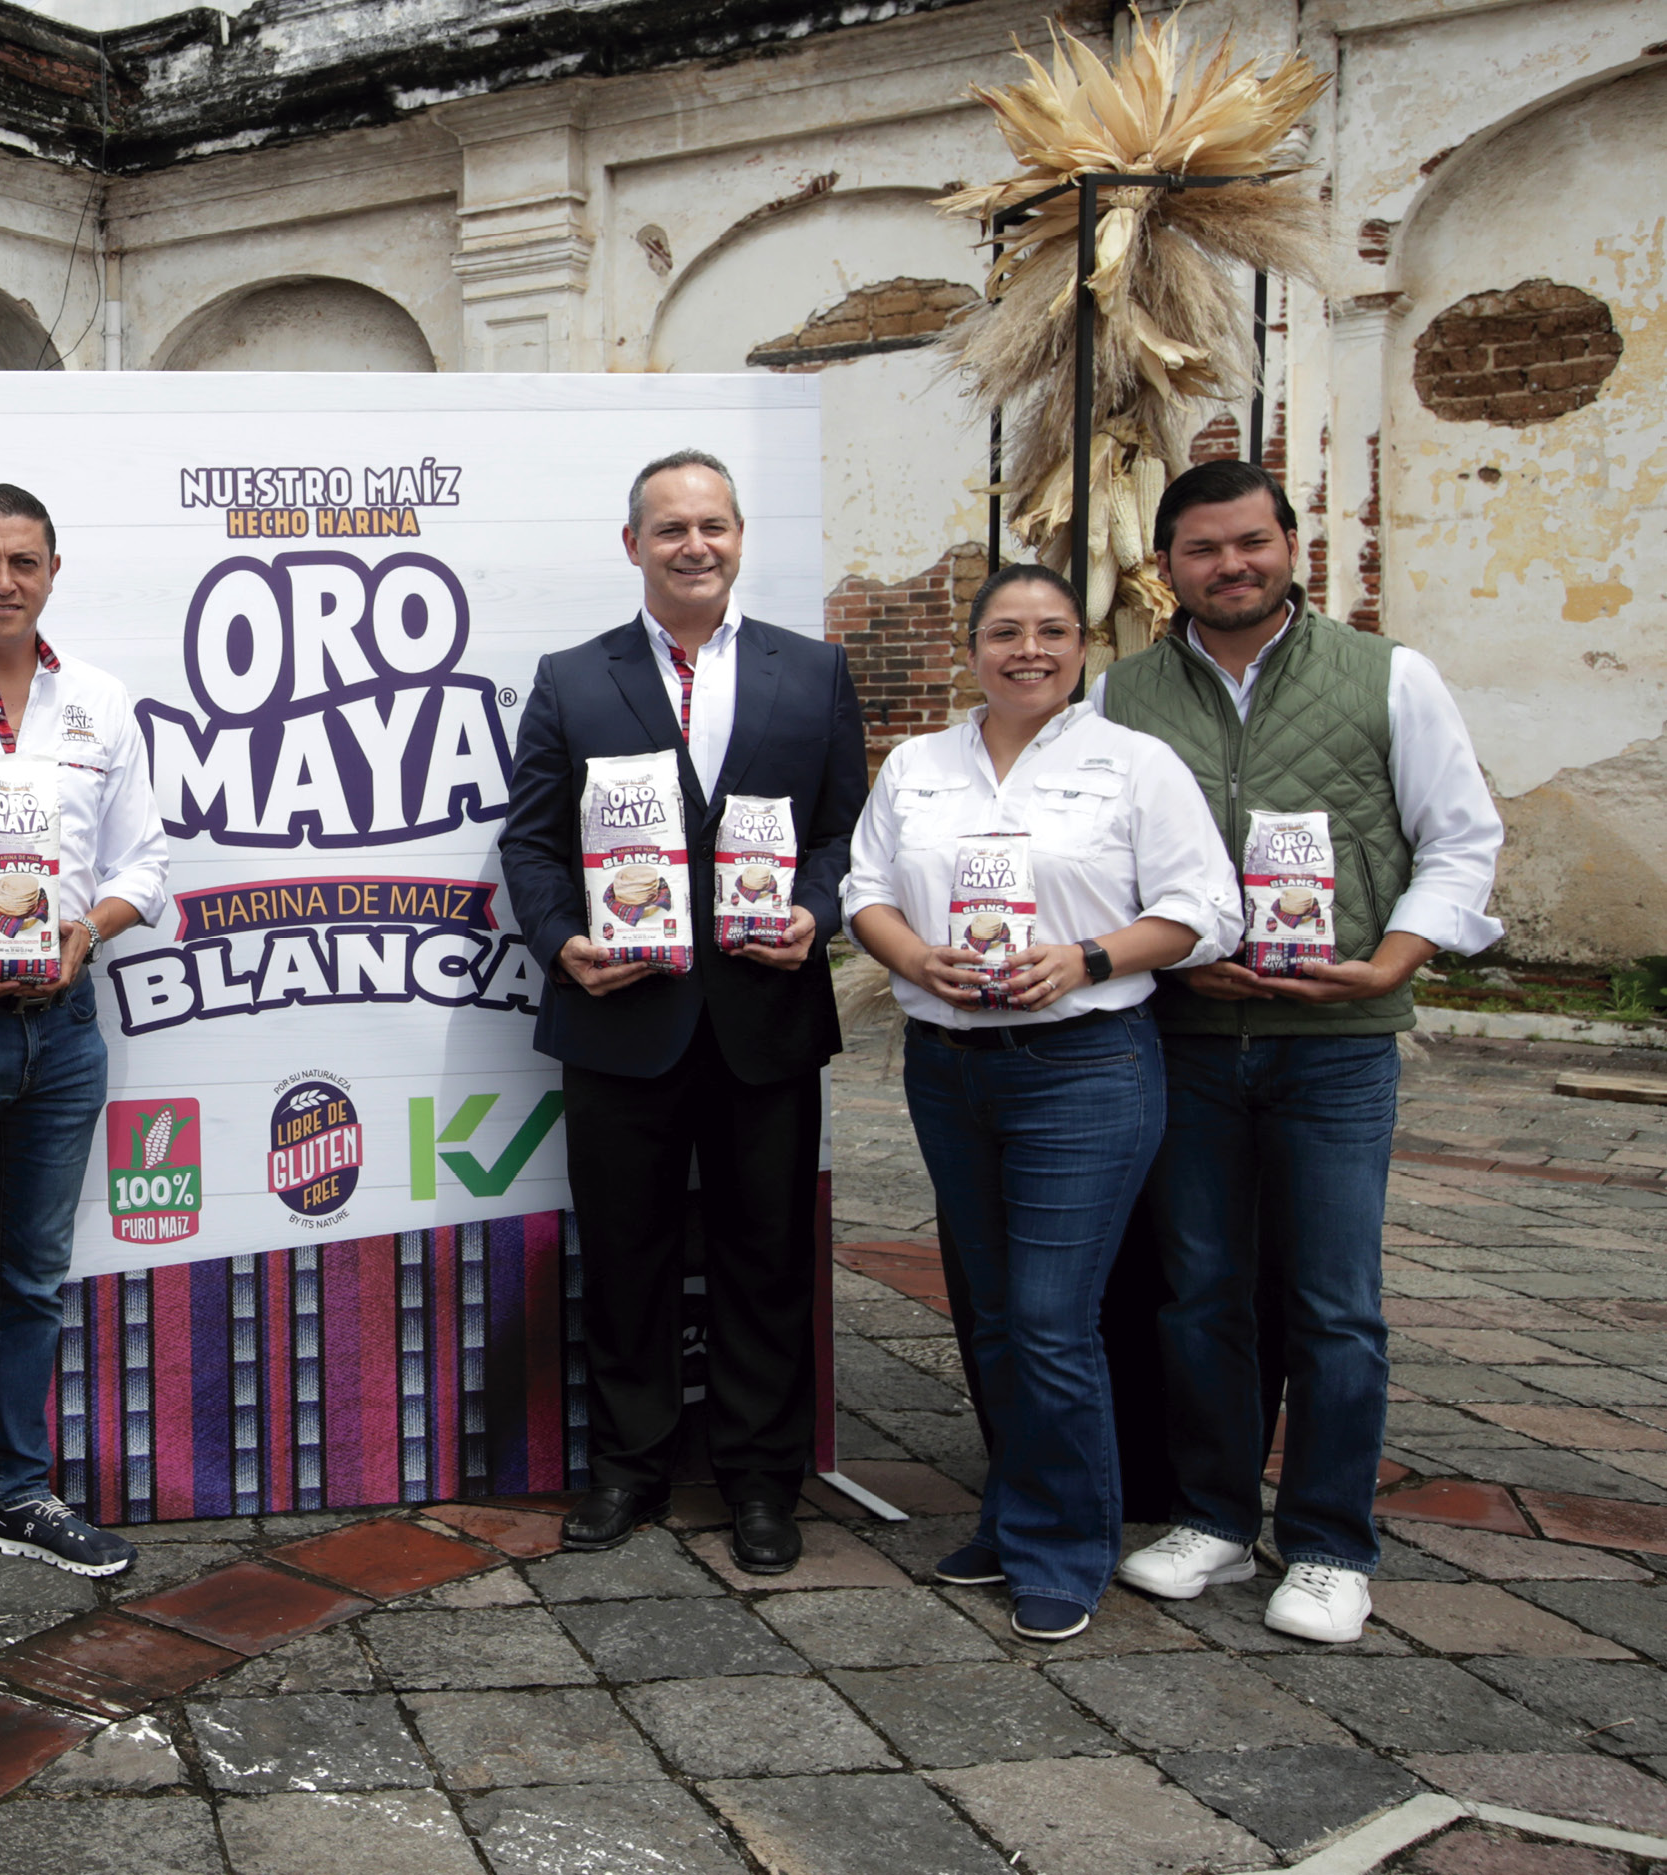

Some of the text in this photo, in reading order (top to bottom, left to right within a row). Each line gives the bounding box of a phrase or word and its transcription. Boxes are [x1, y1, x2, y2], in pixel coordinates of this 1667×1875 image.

[181, 457, 462, 508] NUESTRO MAÍZ
[226, 507, 421, 538] HECHO HARINA
[184, 551, 470, 728] ORO
[65, 705, 86, 718] ORO
[134, 672, 512, 849] MAYA
[609, 786, 655, 810] ORO
[601, 800, 666, 828] MAYA
[741, 814, 777, 829] ORO
[733, 825, 784, 842] MAYA
[1270, 831, 1312, 851] ORO
[602, 853, 671, 870] BLANCA
[734, 856, 781, 868] BLANCA
[969, 857, 1010, 873] ORO
[1265, 845, 1324, 865] MAYA
[961, 870, 1016, 889] MAYA
[1270, 879, 1324, 890] BLANCA
[200, 883, 473, 930] HARINA DE MAÍZ
[962, 904, 1014, 915] BLANCA
[273, 1069, 352, 1095] POR SU NATURALEZA
[277, 1099, 348, 1146] LIBRE DE
[273, 1126, 357, 1190] GLUTEN
[116, 1172, 194, 1210] 100%
[303, 1175, 340, 1210] FREE
[121, 1217, 156, 1240] PURO
[289, 1208, 350, 1229] BY ITS NATURE
